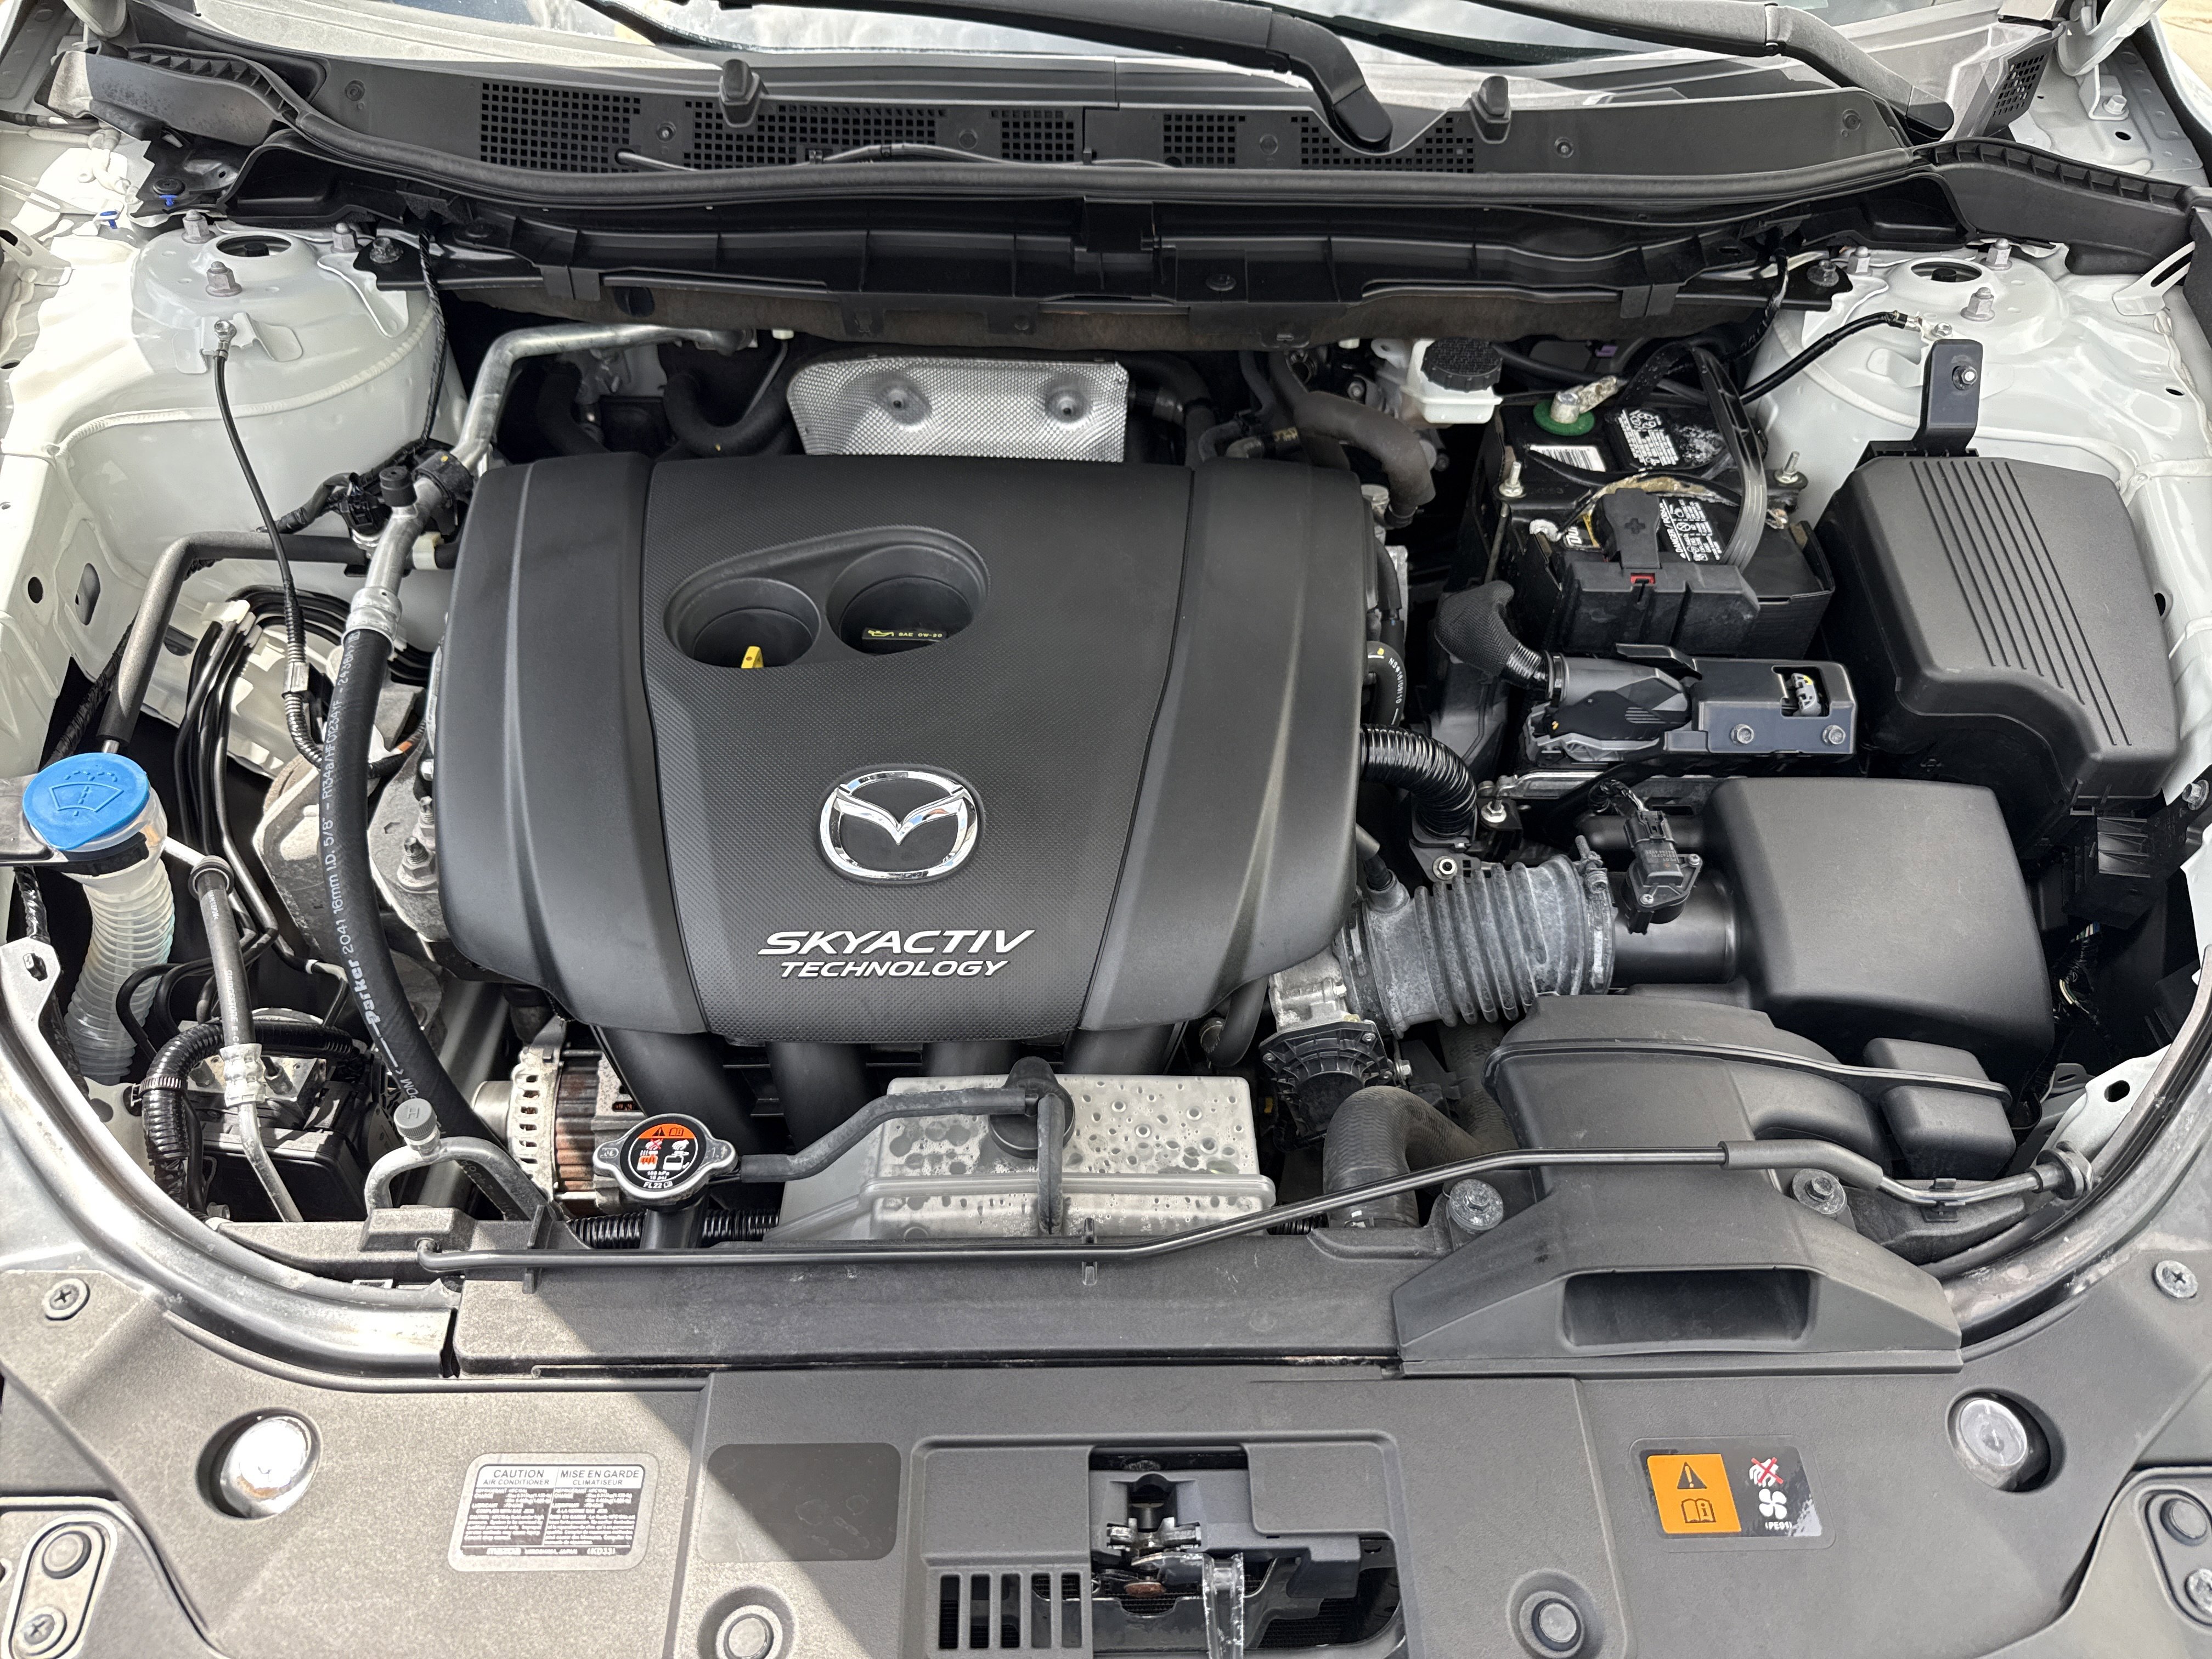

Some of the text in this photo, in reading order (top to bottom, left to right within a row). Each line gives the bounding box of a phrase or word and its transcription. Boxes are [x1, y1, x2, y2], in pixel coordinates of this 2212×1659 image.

[325, 850, 337, 872] I.D.
[329, 873, 344, 915] 16mm
[335, 919, 354, 955] 2041
[758, 929, 1036, 956] SKYACTIV
[780, 960, 1009, 979] TECHNOLOGY
[348, 959, 381, 1025] Parker
[406, 1107, 420, 1119] H
[494, 1469, 545, 1479] CAUTION
[560, 1470, 640, 1479] MISE EN GARDE
[587, 1547, 616, 1555] (KD33)
